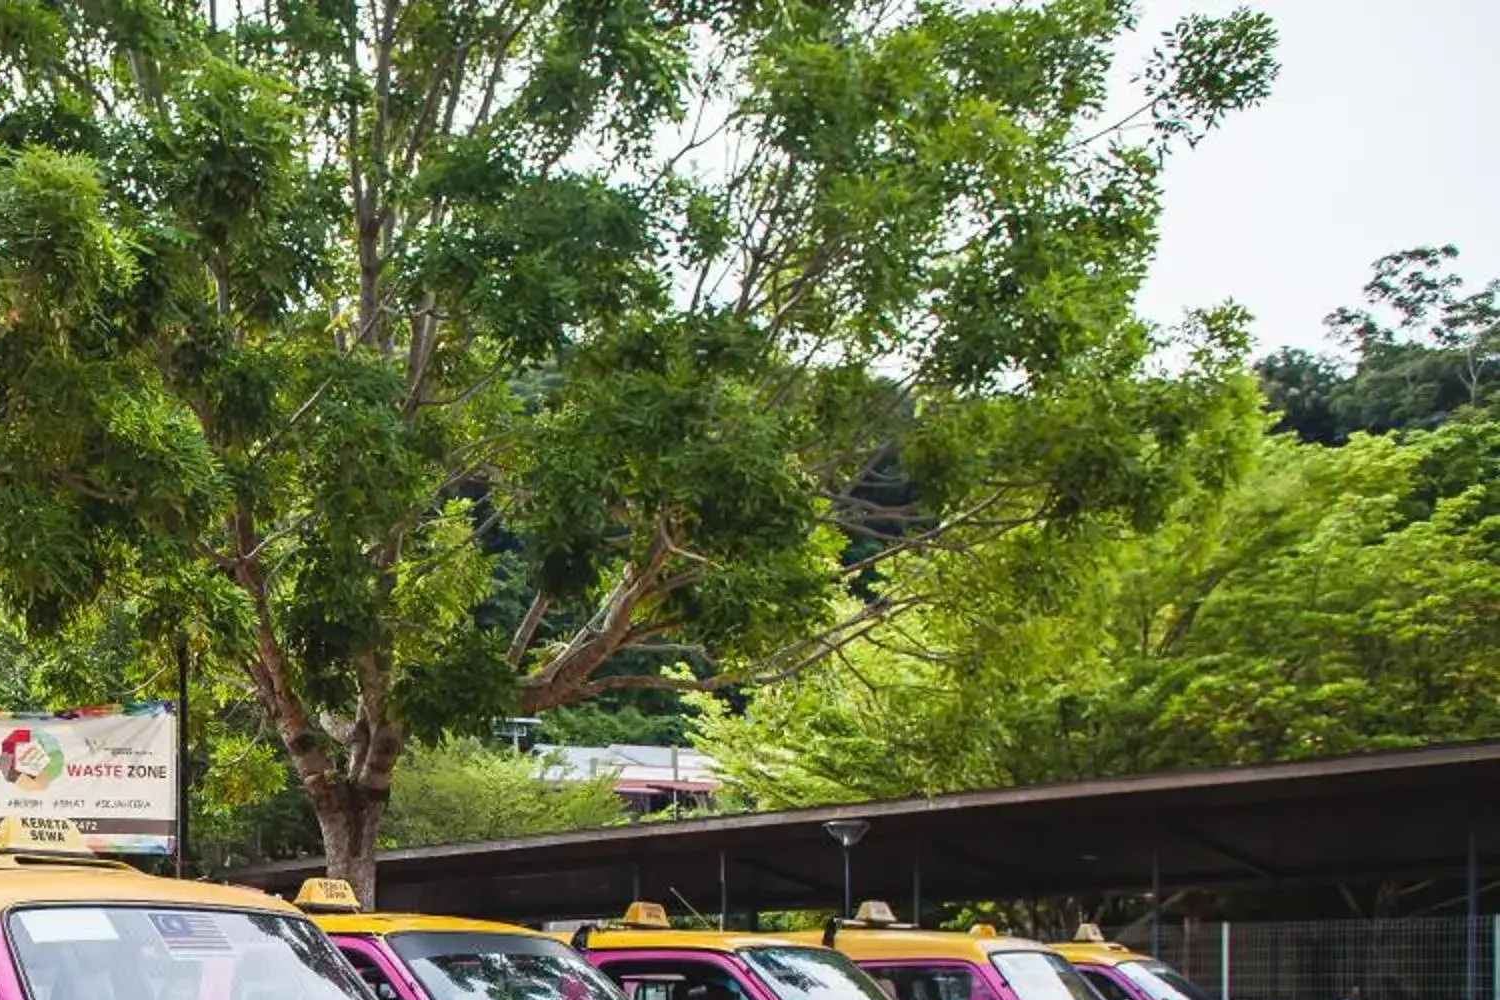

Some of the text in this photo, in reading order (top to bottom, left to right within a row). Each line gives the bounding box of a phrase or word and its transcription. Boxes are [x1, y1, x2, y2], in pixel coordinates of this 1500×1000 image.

[67, 764, 123, 777] WASTE
[127, 765, 167, 778] ZONE
[20, 817, 70, 830] KERETA
[30, 829, 66, 842] SEWA
